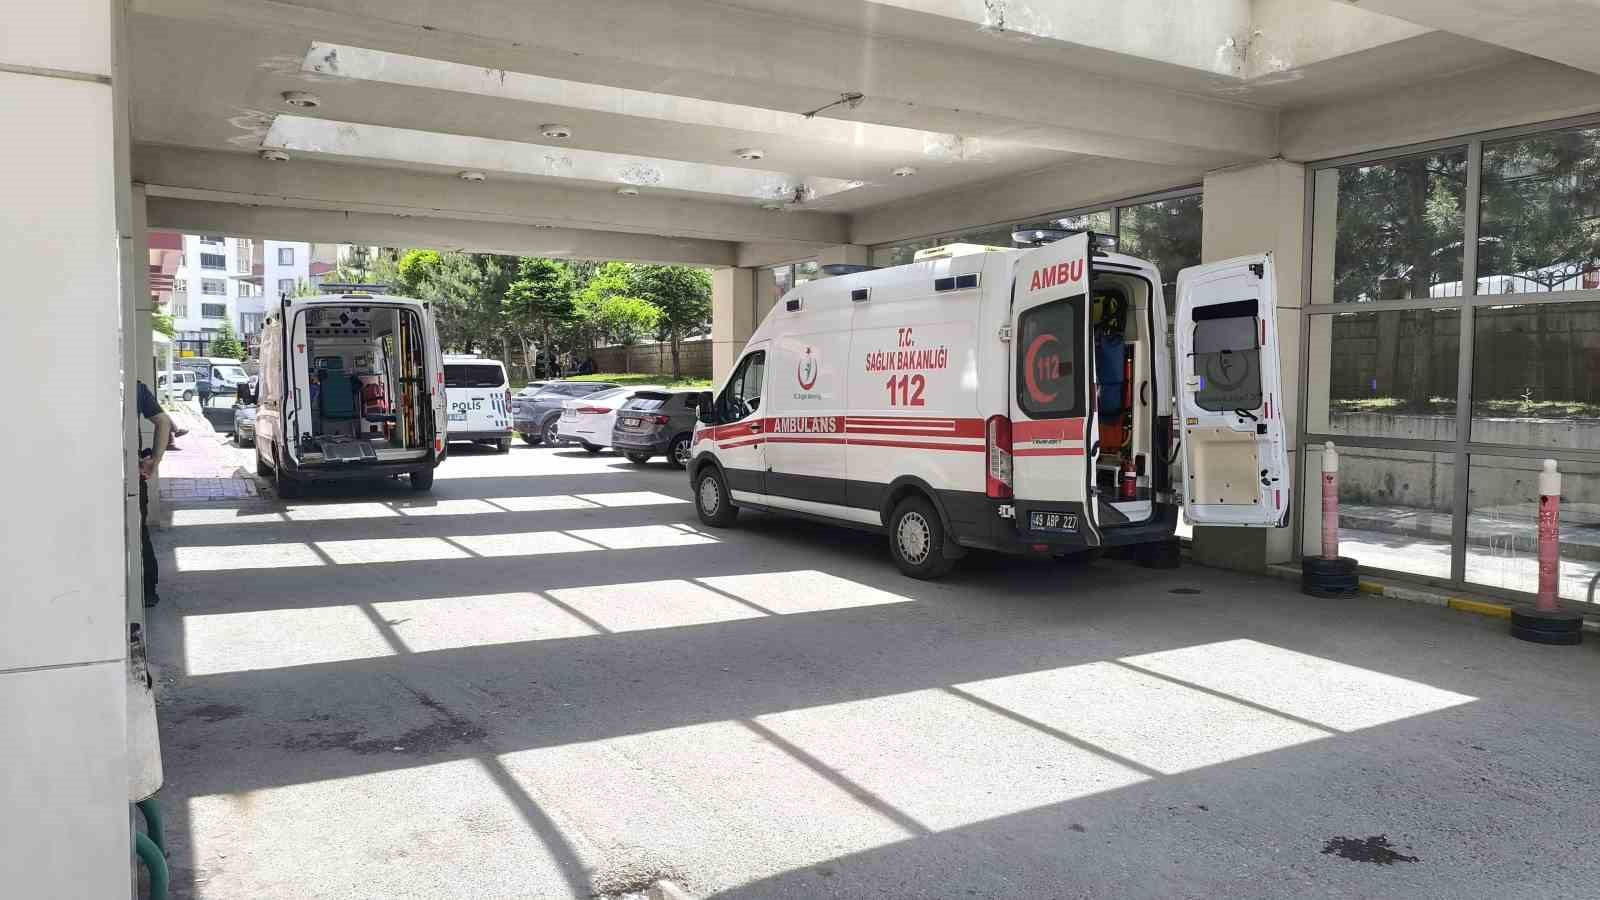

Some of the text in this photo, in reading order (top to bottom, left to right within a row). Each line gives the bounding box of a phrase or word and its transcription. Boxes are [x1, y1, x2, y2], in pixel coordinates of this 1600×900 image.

[1030, 259, 1084, 291] AMBU
[898, 327, 914, 347] T.C.
[866, 345, 947, 371] SAĞLIK BAKANLIĞI
[1038, 355, 1060, 381] 112
[886, 374, 925, 406] 112
[774, 417, 836, 433] AMBULANS
[1063, 516, 1077, 529] 227
